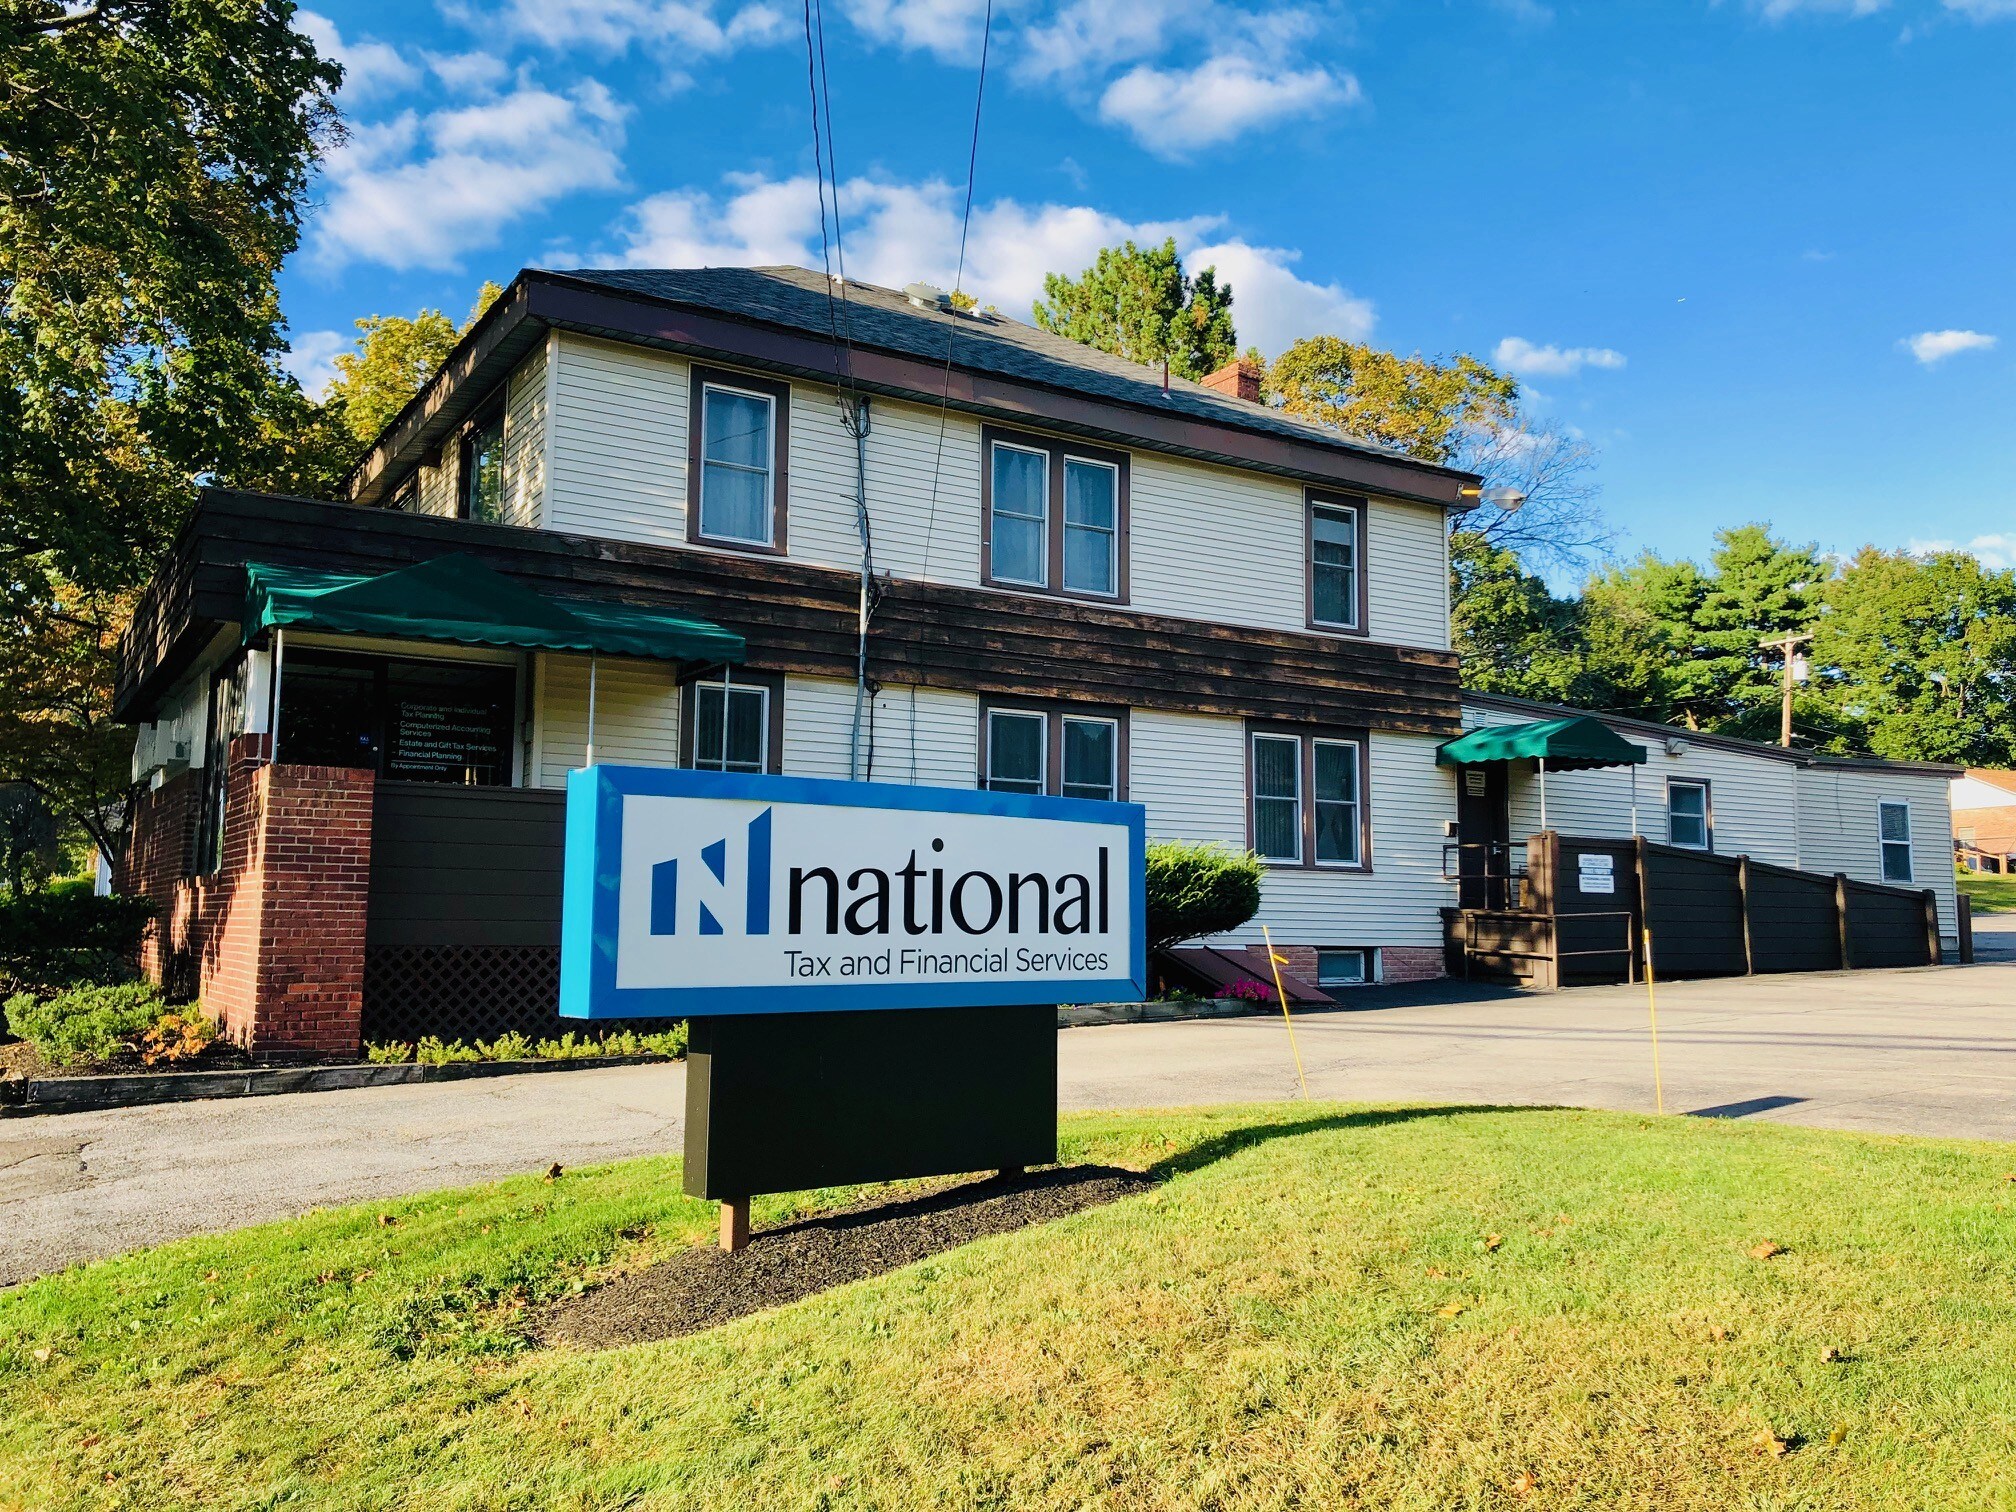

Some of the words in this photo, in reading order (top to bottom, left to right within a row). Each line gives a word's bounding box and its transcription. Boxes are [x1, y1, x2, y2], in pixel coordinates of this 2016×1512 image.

[400, 720, 450, 731] Computerized
[451, 725, 491, 735] Accounting
[400, 728, 432, 737] Services
[399, 739, 423, 747] Estate
[438, 741, 452, 749] Gift
[452, 742, 465, 750] Tax
[465, 743, 497, 752] Services
[398, 749, 431, 759] Financial
[431, 751, 463, 761] Planning
[399, 763, 434, 771] Appointment
[787, 836, 1109, 935] national
[783, 949, 832, 977] Tax
[840, 947, 891, 977] and
[900, 946, 1009, 976] Financial
[1015, 947, 1109, 973] Services
